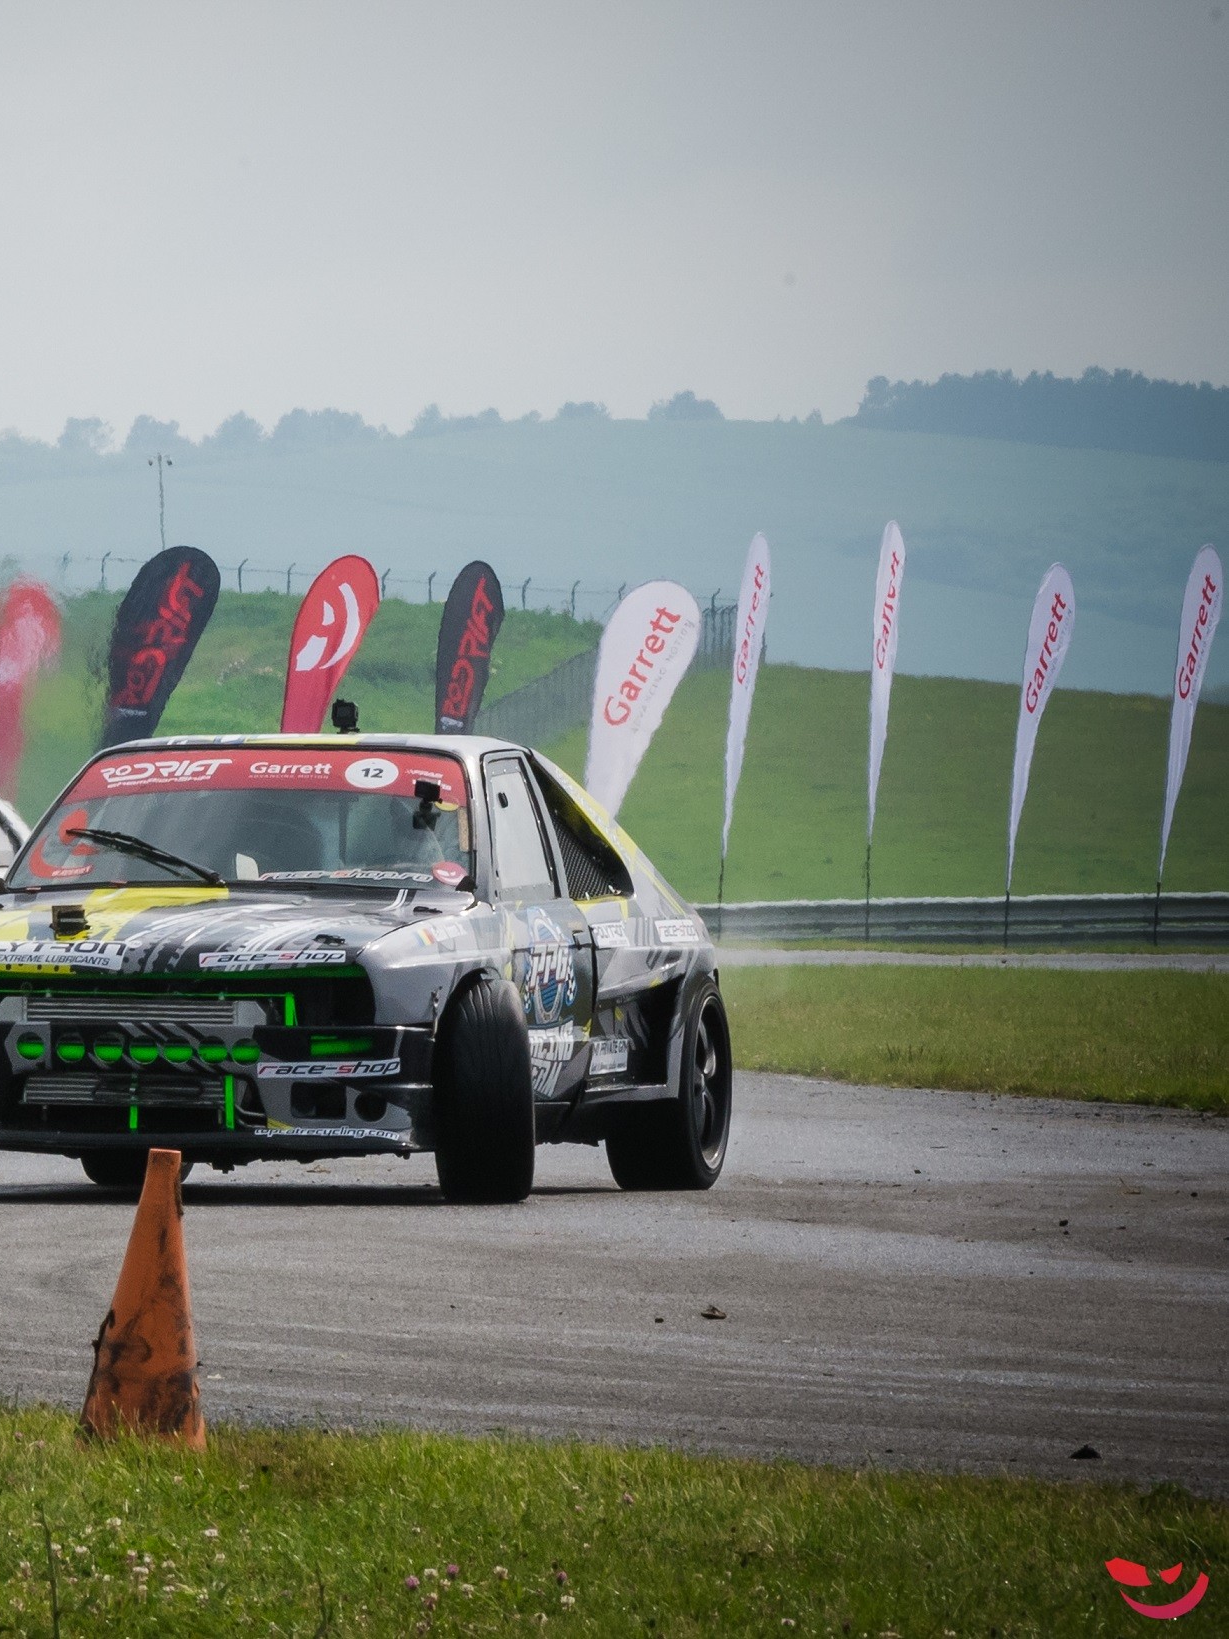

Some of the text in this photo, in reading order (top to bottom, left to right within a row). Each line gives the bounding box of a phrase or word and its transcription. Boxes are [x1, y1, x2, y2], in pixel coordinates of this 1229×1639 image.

[1178, 573, 1216, 699] Garrett
[1026, 592, 1066, 714] Garrett
[603, 607, 681, 726] Garrett
[101, 758, 385, 782] RODRIFT Garrett 12
[45, 954, 111, 966] LUBRICANTS
[199, 950, 345, 965] race-shop
[258, 1061, 400, 1075] race-shop
